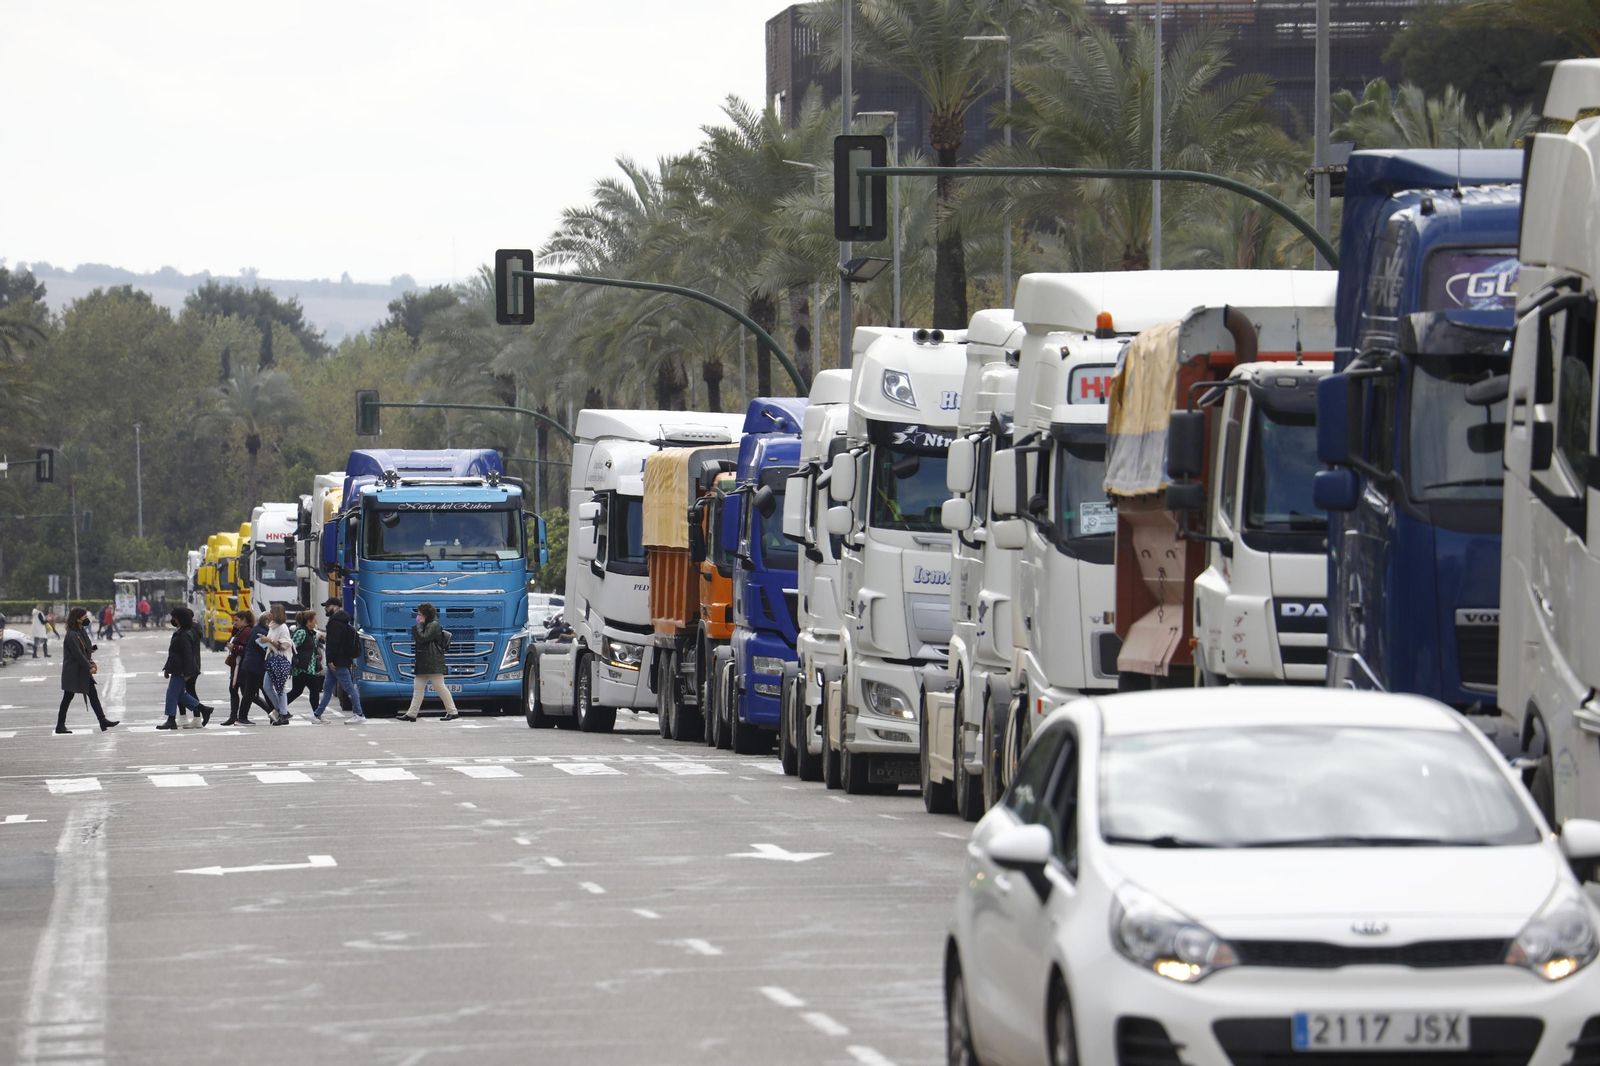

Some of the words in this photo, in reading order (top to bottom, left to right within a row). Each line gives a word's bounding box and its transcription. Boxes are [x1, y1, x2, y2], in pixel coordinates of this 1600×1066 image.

[437, 502, 453, 510] del
[877, 768, 921, 776] DYSCA
[1314, 1014, 1390, 1044] 2117
[1404, 1014, 1461, 1044] JSX
